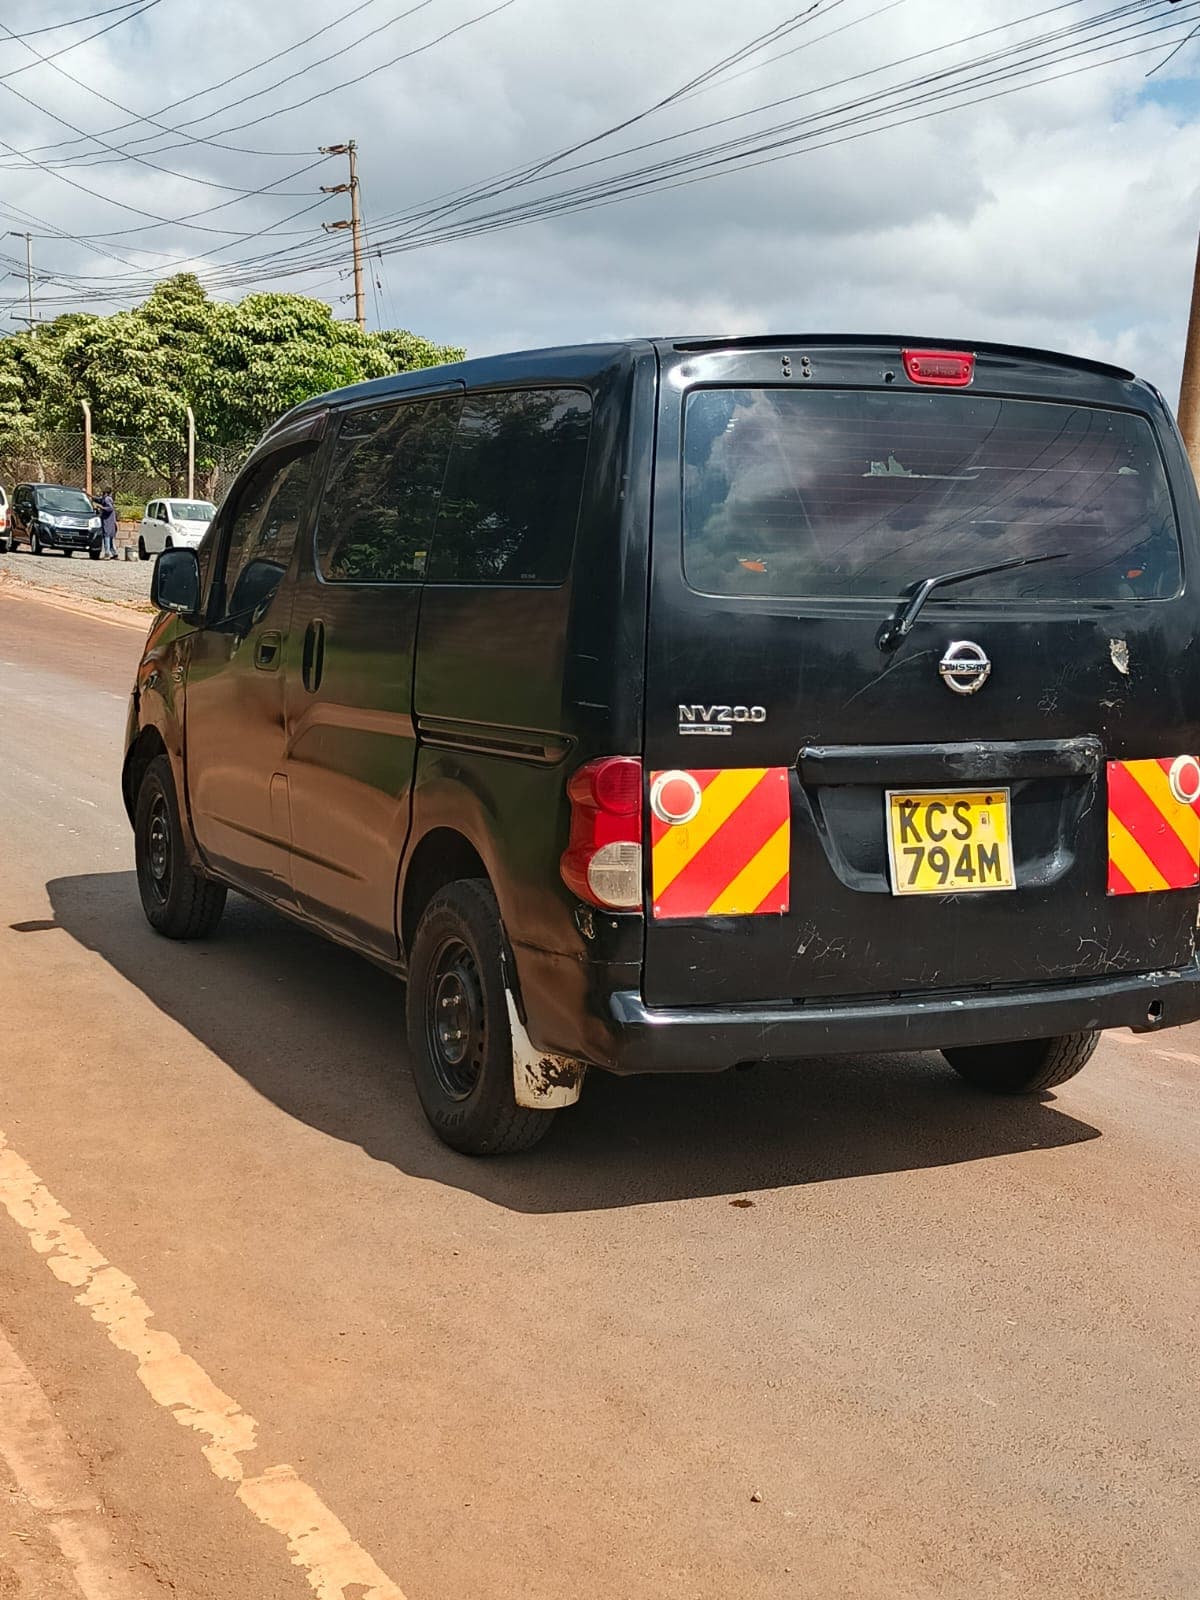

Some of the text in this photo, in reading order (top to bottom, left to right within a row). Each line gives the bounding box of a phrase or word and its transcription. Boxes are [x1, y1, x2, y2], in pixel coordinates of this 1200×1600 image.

[679, 704, 766, 722] NV200
[899, 800, 973, 844] KCS
[903, 842, 1002, 885] 794M
